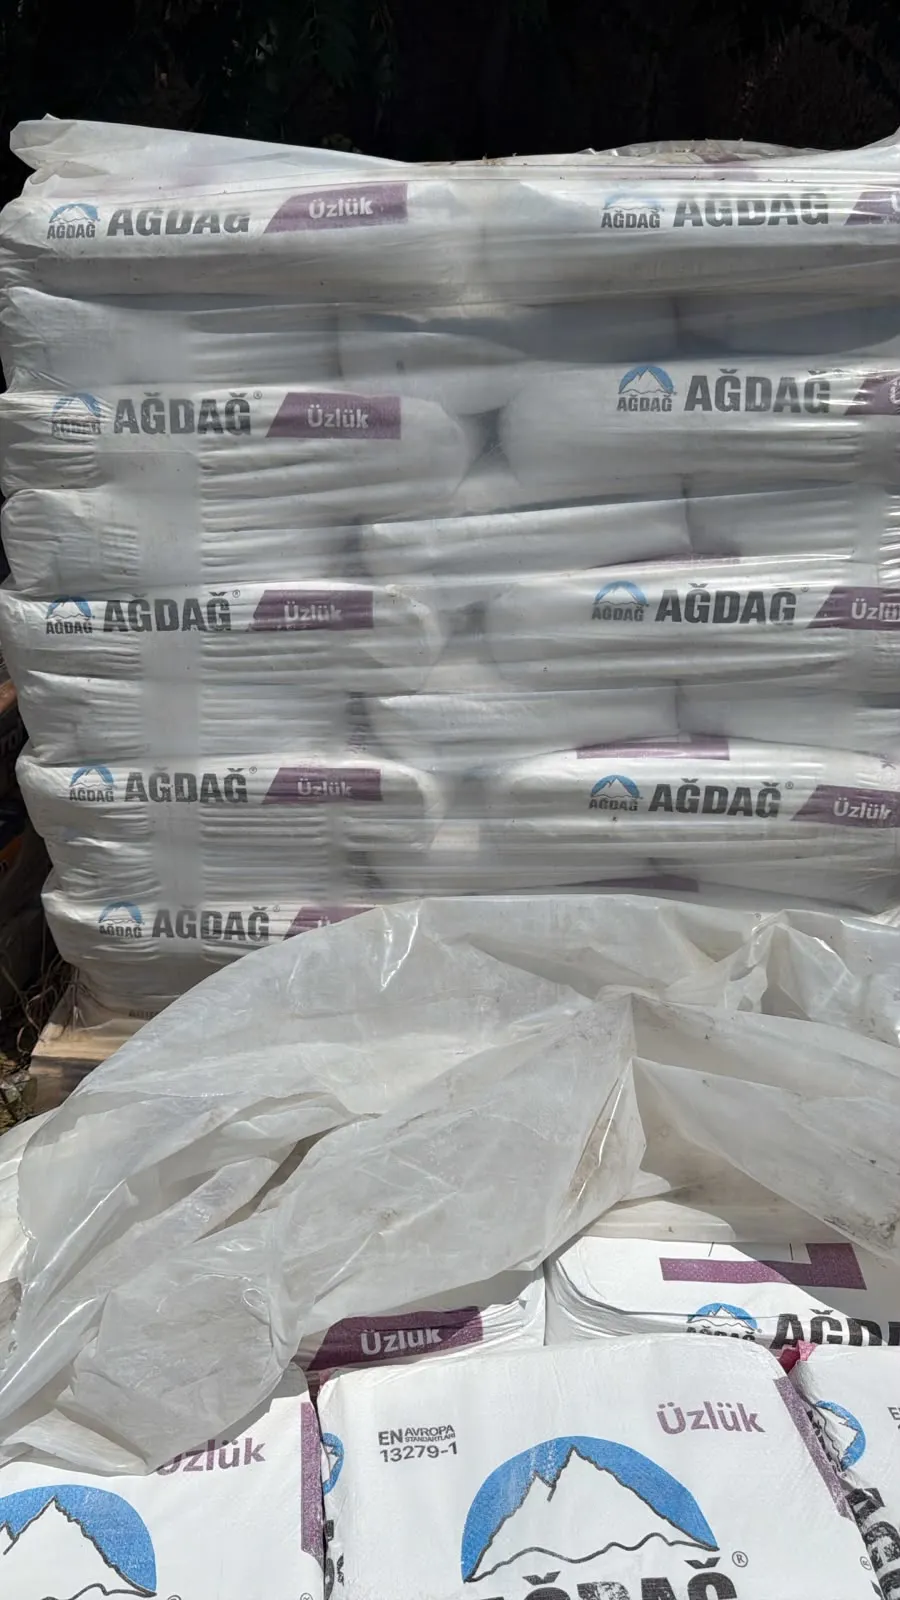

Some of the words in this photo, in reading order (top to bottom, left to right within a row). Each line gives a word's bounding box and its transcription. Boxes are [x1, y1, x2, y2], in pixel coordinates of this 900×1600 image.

[47, 221, 96, 239] AĞDAĞ
[308, 197, 373, 219] Üzlük
[601, 209, 660, 229] AĞDAĞ
[616, 394, 672, 413] AĞDAĞ
[684, 369, 831, 414] AĞDAĞ
[114, 392, 251, 435] AĞDAĞ
[307, 405, 369, 429] Üzlük
[46, 618, 94, 635] AĞDAĞ
[103, 592, 232, 633] AĞDAĞ
[284, 600, 342, 622] Üzlük
[591, 604, 645, 623] AĞDAĞ
[655, 583, 797, 626] AĞDAĞ
[125, 767, 249, 804] AĞDAĞ
[297, 777, 353, 798] Üzlük
[648, 778, 782, 818] AĞDAĞ
[833, 799, 893, 822] Üzlük
[152, 906, 270, 943] AĞDAĞ
[377, 1428, 404, 1446] EN
[404, 1424, 455, 1437] AVROPA
[656, 1401, 764, 1435] Üzlük
[379, 1441, 458, 1463] 13279-1
